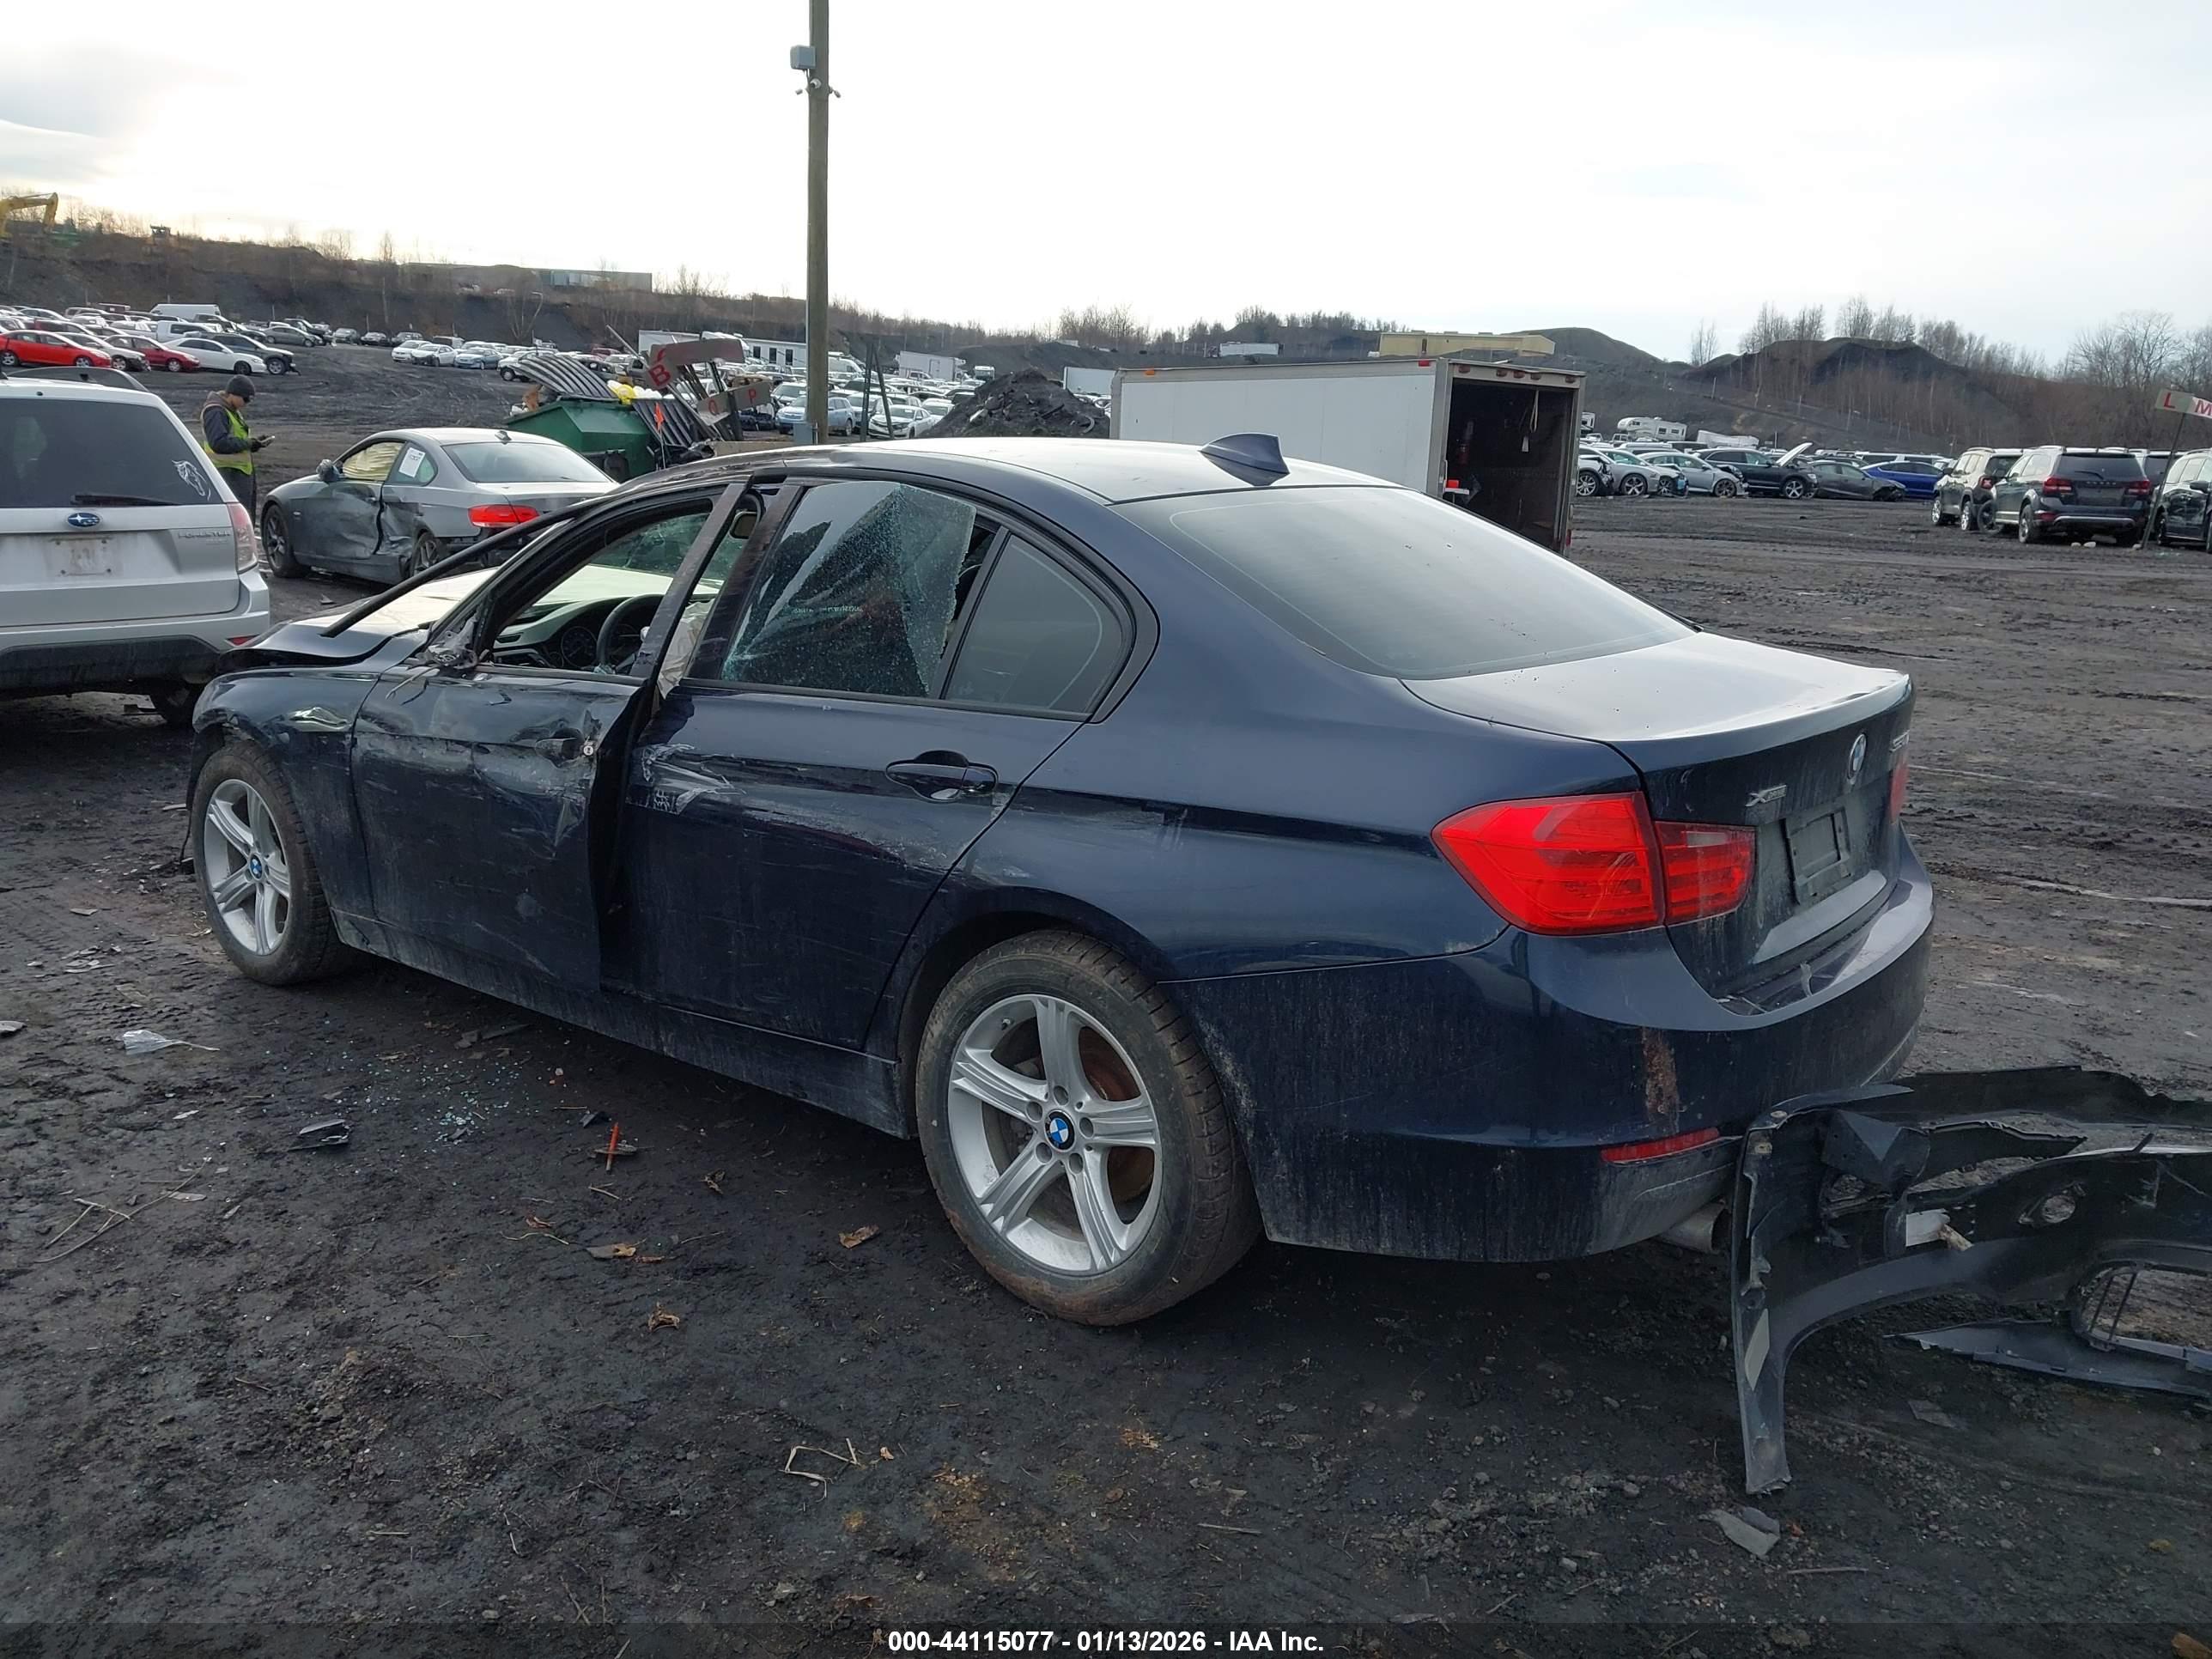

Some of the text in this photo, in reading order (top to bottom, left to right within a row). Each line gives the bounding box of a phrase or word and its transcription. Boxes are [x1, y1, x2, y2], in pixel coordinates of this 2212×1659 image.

[648, 363, 672, 386] B
[748, 388, 757, 404] P
[2163, 392, 2212, 416] L M
